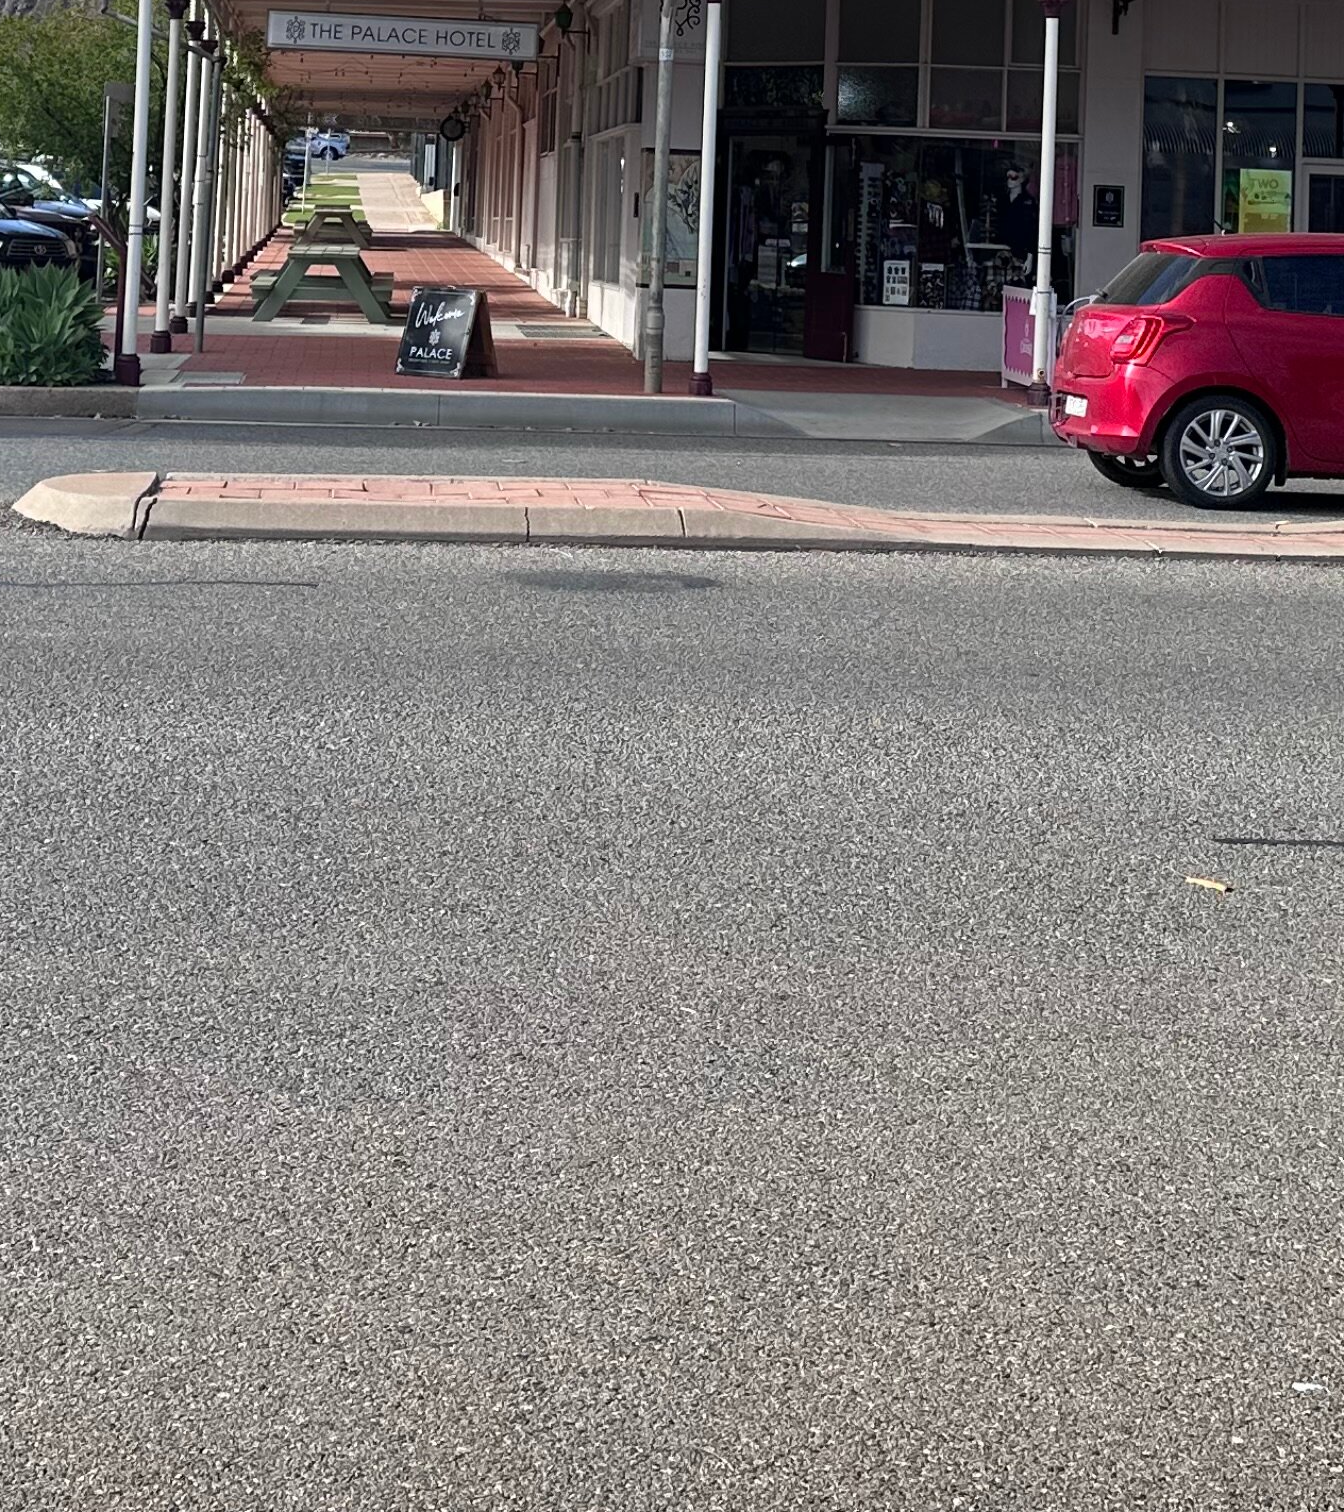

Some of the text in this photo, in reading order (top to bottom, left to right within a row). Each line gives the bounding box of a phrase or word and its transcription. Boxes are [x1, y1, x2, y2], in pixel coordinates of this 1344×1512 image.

[310, 22, 496, 49] THE PALACE HOTEL
[409, 346, 453, 360] PALACE
